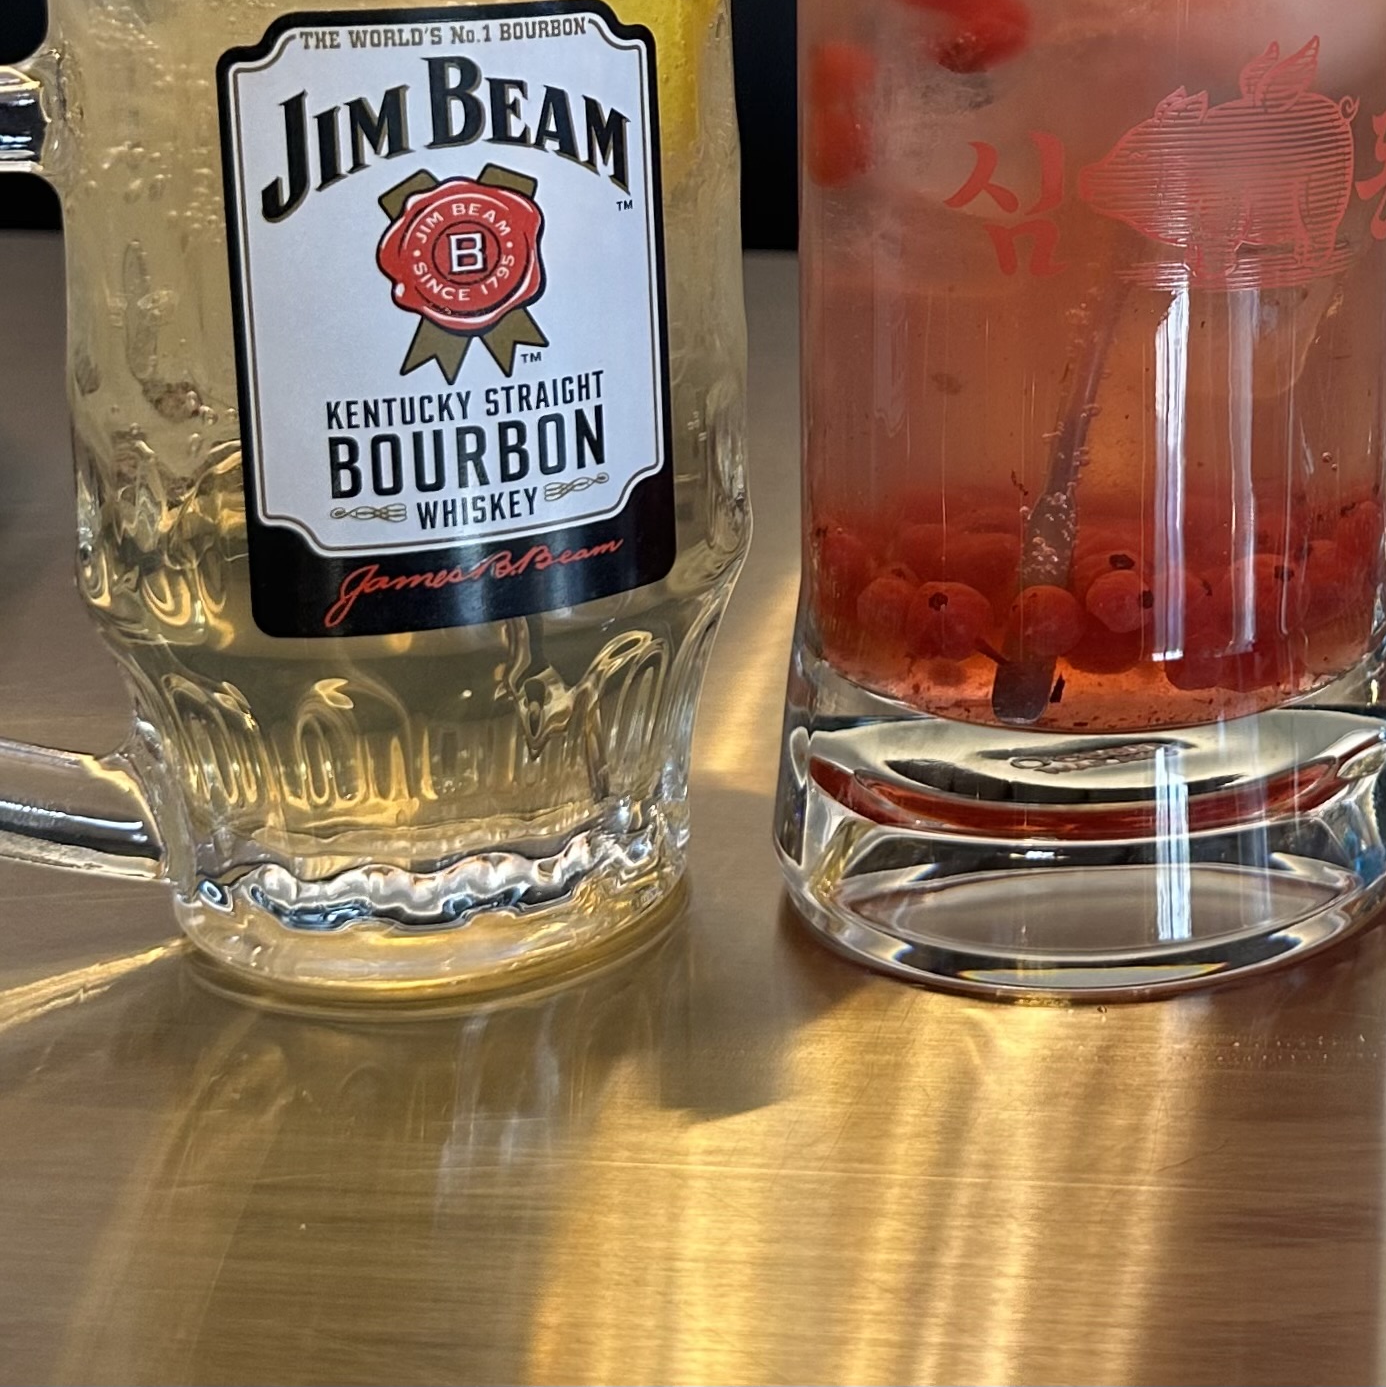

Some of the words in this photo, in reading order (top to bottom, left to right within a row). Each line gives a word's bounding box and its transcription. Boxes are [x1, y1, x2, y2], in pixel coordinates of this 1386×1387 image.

[300, 29, 341, 50] THE
[349, 24, 443, 48] WORLD'S
[499, 16, 587, 42] BOURBON
[261, 84, 416, 223] JIM
[420, 55, 632, 196] BEAM
[415, 211, 445, 244] JIM
[452, 202, 511, 236] BEAM
[942, 131, 1068, 276] 심
[413, 261, 471, 301] SINCE
[480, 254, 515, 295] 1795
[449, 232, 487, 274] B
[326, 390, 471, 430] KENTUCKY
[485, 370, 604, 416] STRAIGHT
[328, 404, 606, 499] BOURBON
[417, 487, 538, 530] WHISKEY
[324, 564, 468, 628] James
